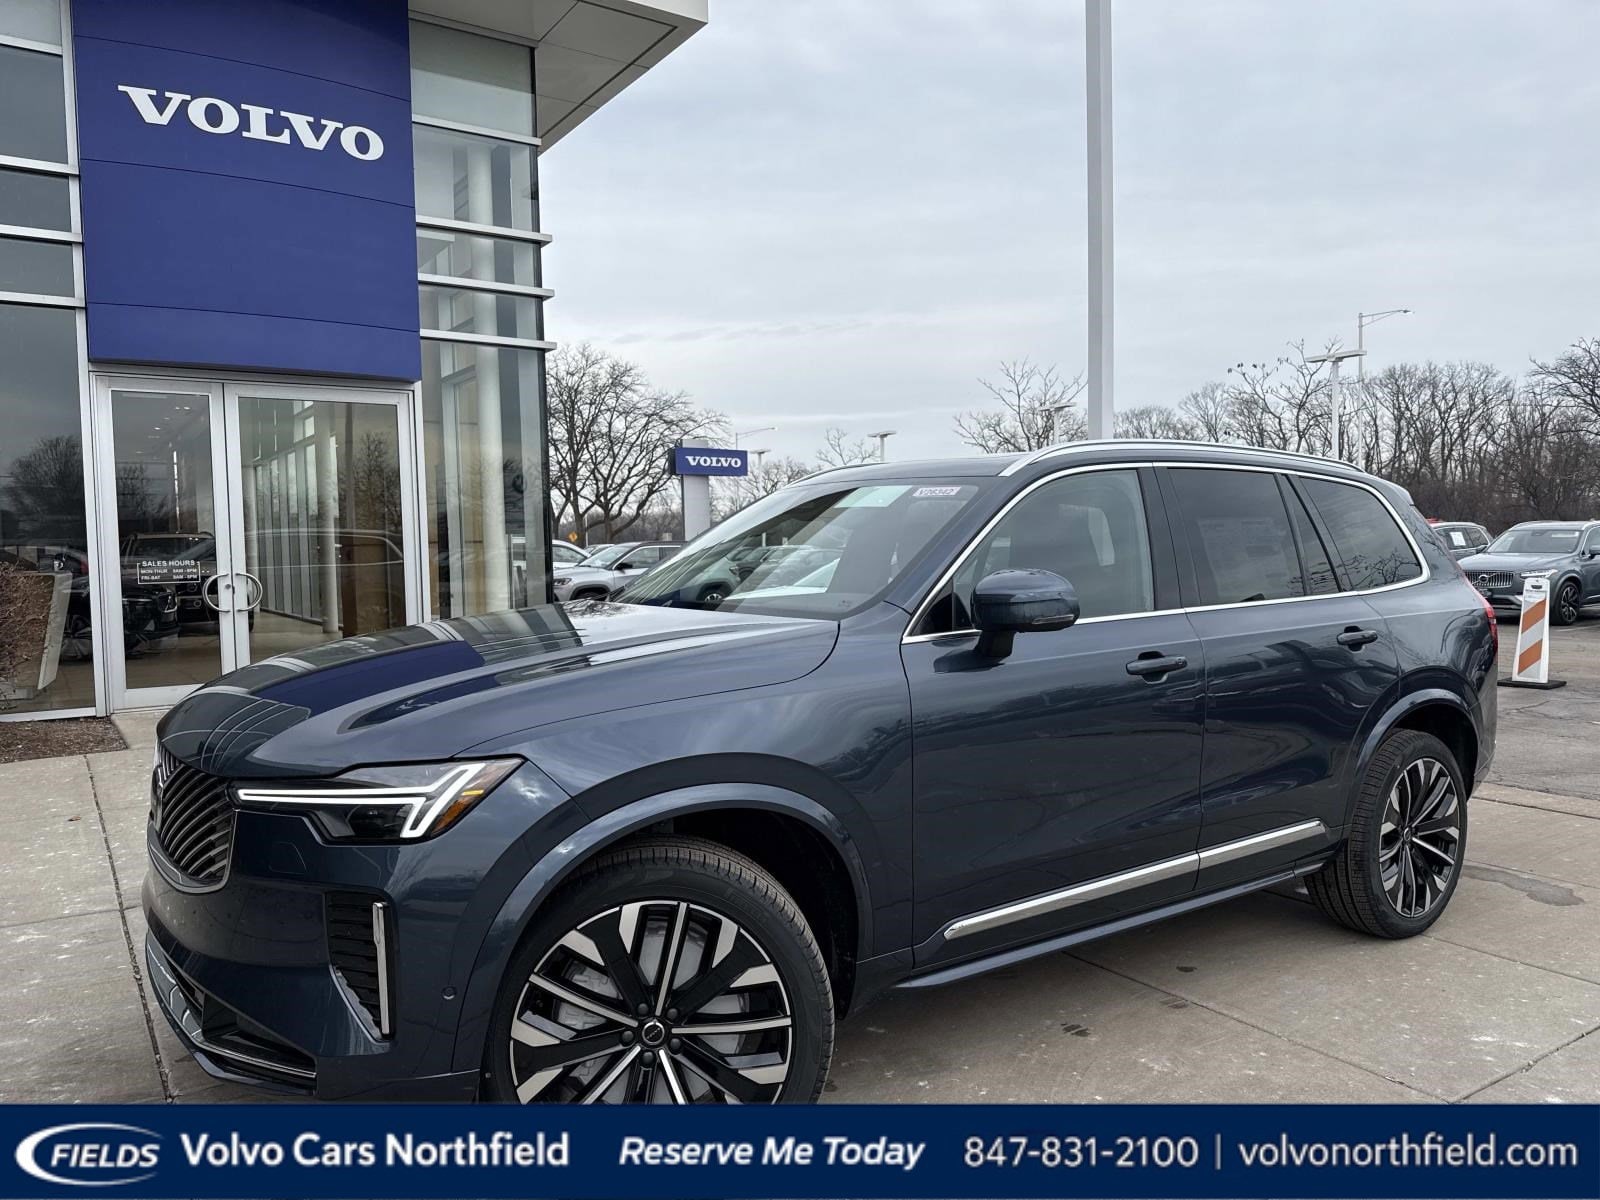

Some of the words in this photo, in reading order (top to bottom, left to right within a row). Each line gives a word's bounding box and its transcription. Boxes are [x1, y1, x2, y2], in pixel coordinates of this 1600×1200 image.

[117, 84, 385, 161] VOLVO
[685, 455, 742, 468] VOLVO
[168, 559, 195, 567] HOURS
